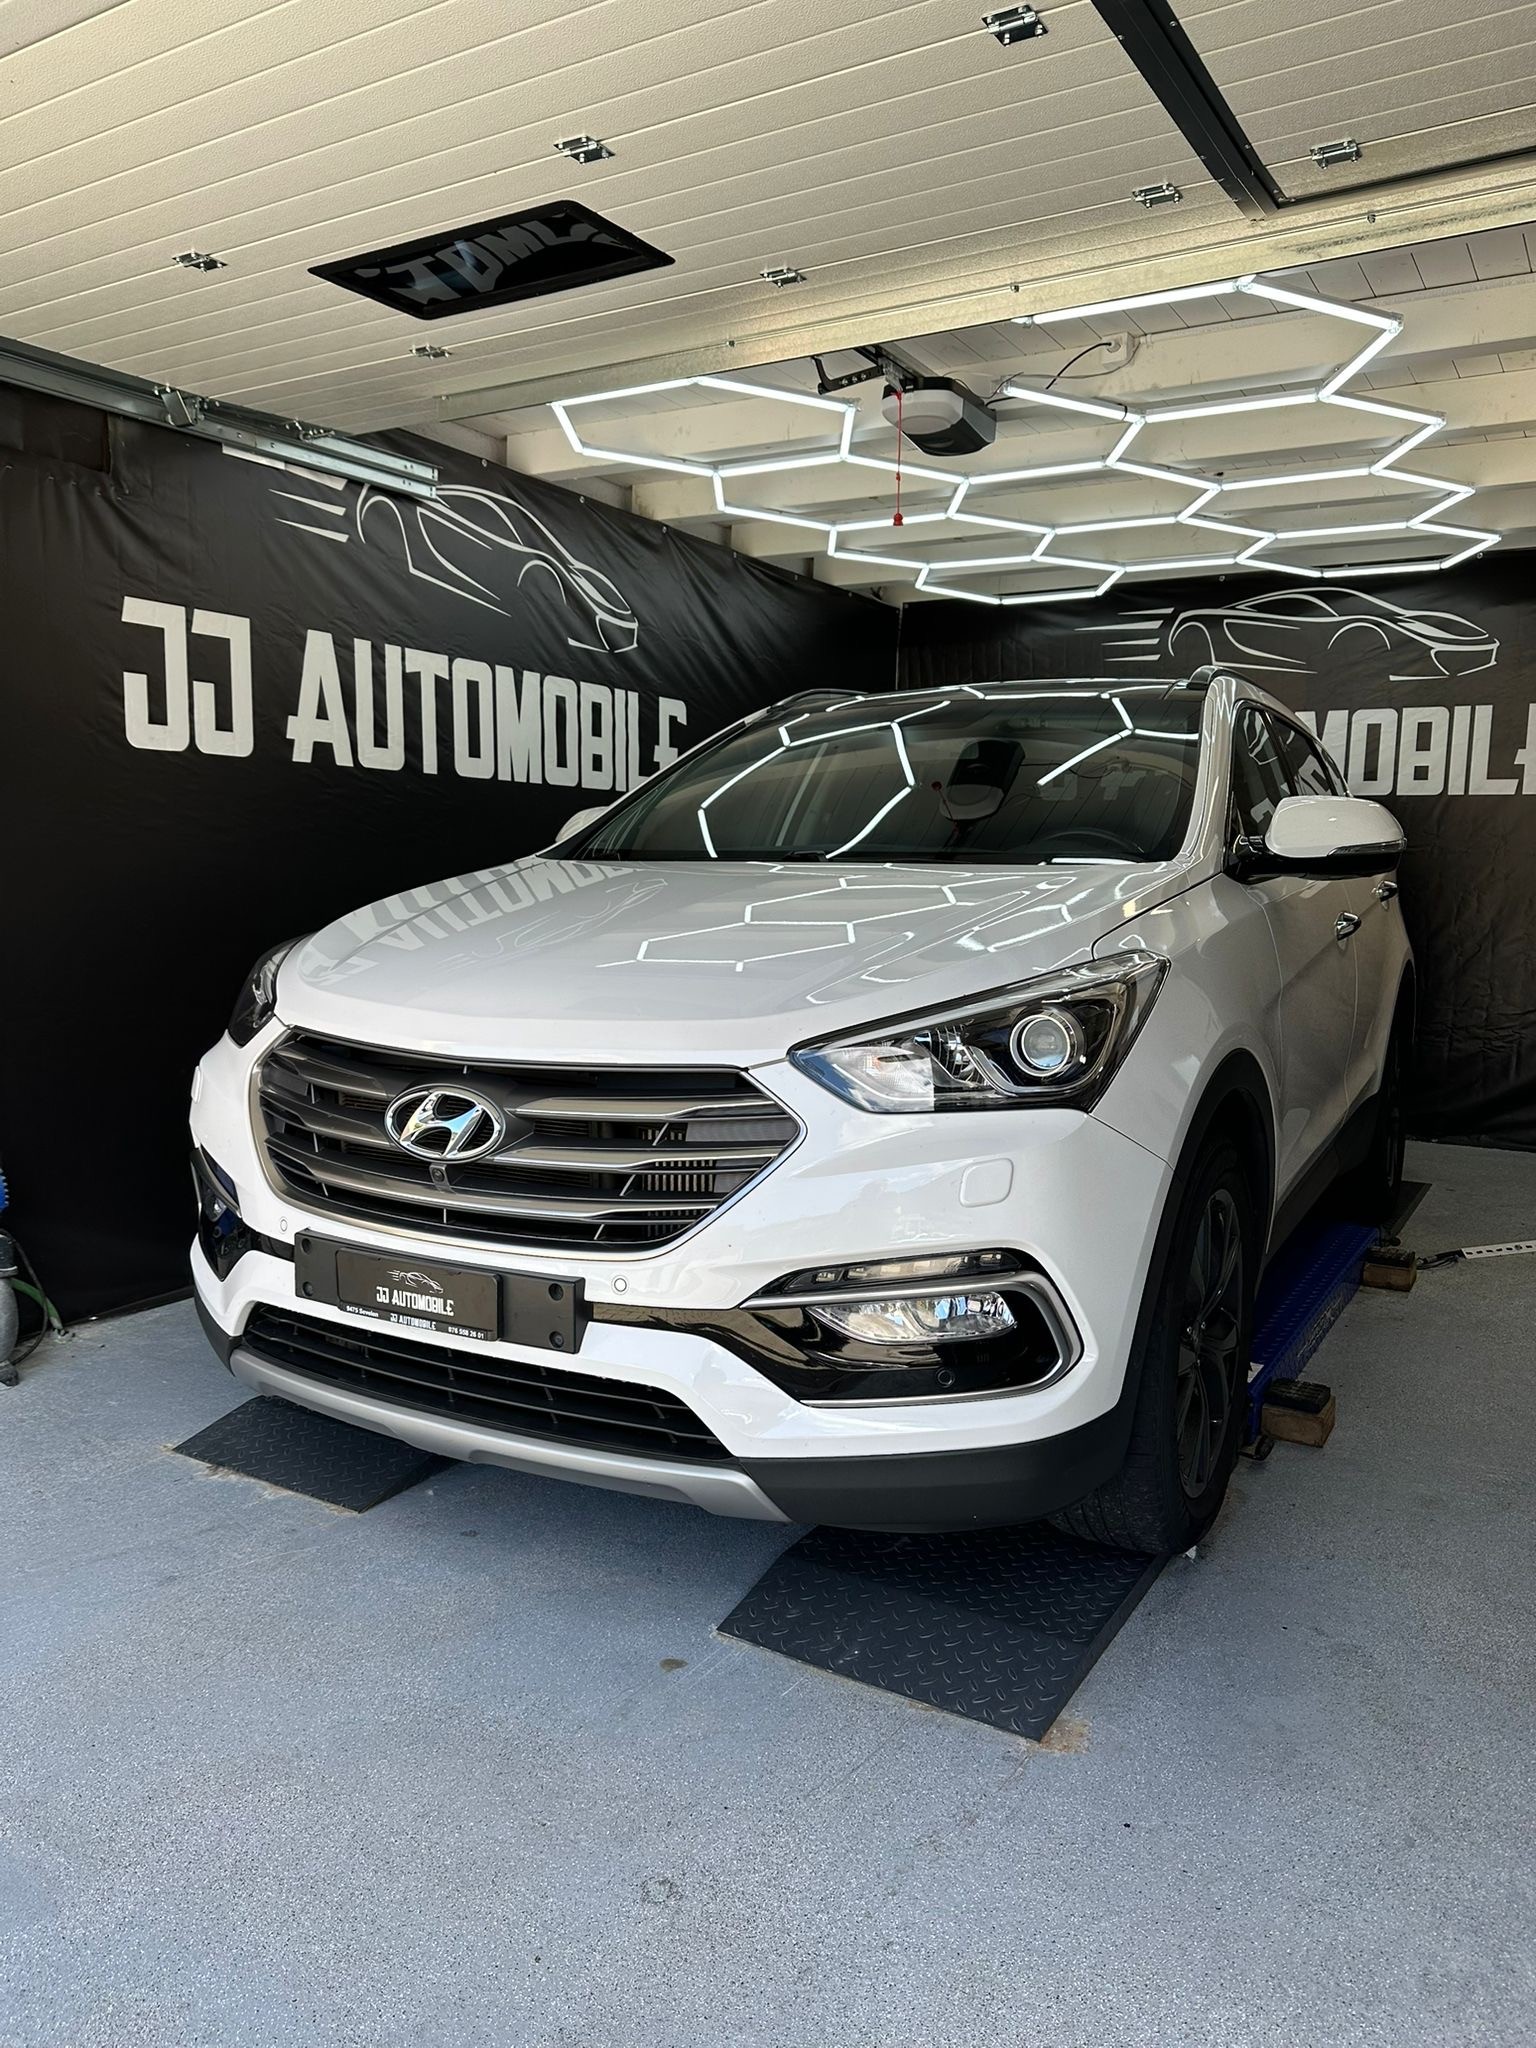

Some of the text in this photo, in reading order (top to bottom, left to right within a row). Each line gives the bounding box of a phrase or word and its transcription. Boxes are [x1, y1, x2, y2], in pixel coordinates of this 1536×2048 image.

[121, 596, 688, 792] JJ AUTOMOBILE
[376, 1286, 455, 1316] JJ AUTOMOBILE
[398, 1315, 437, 1331] AUTOMOBILE
